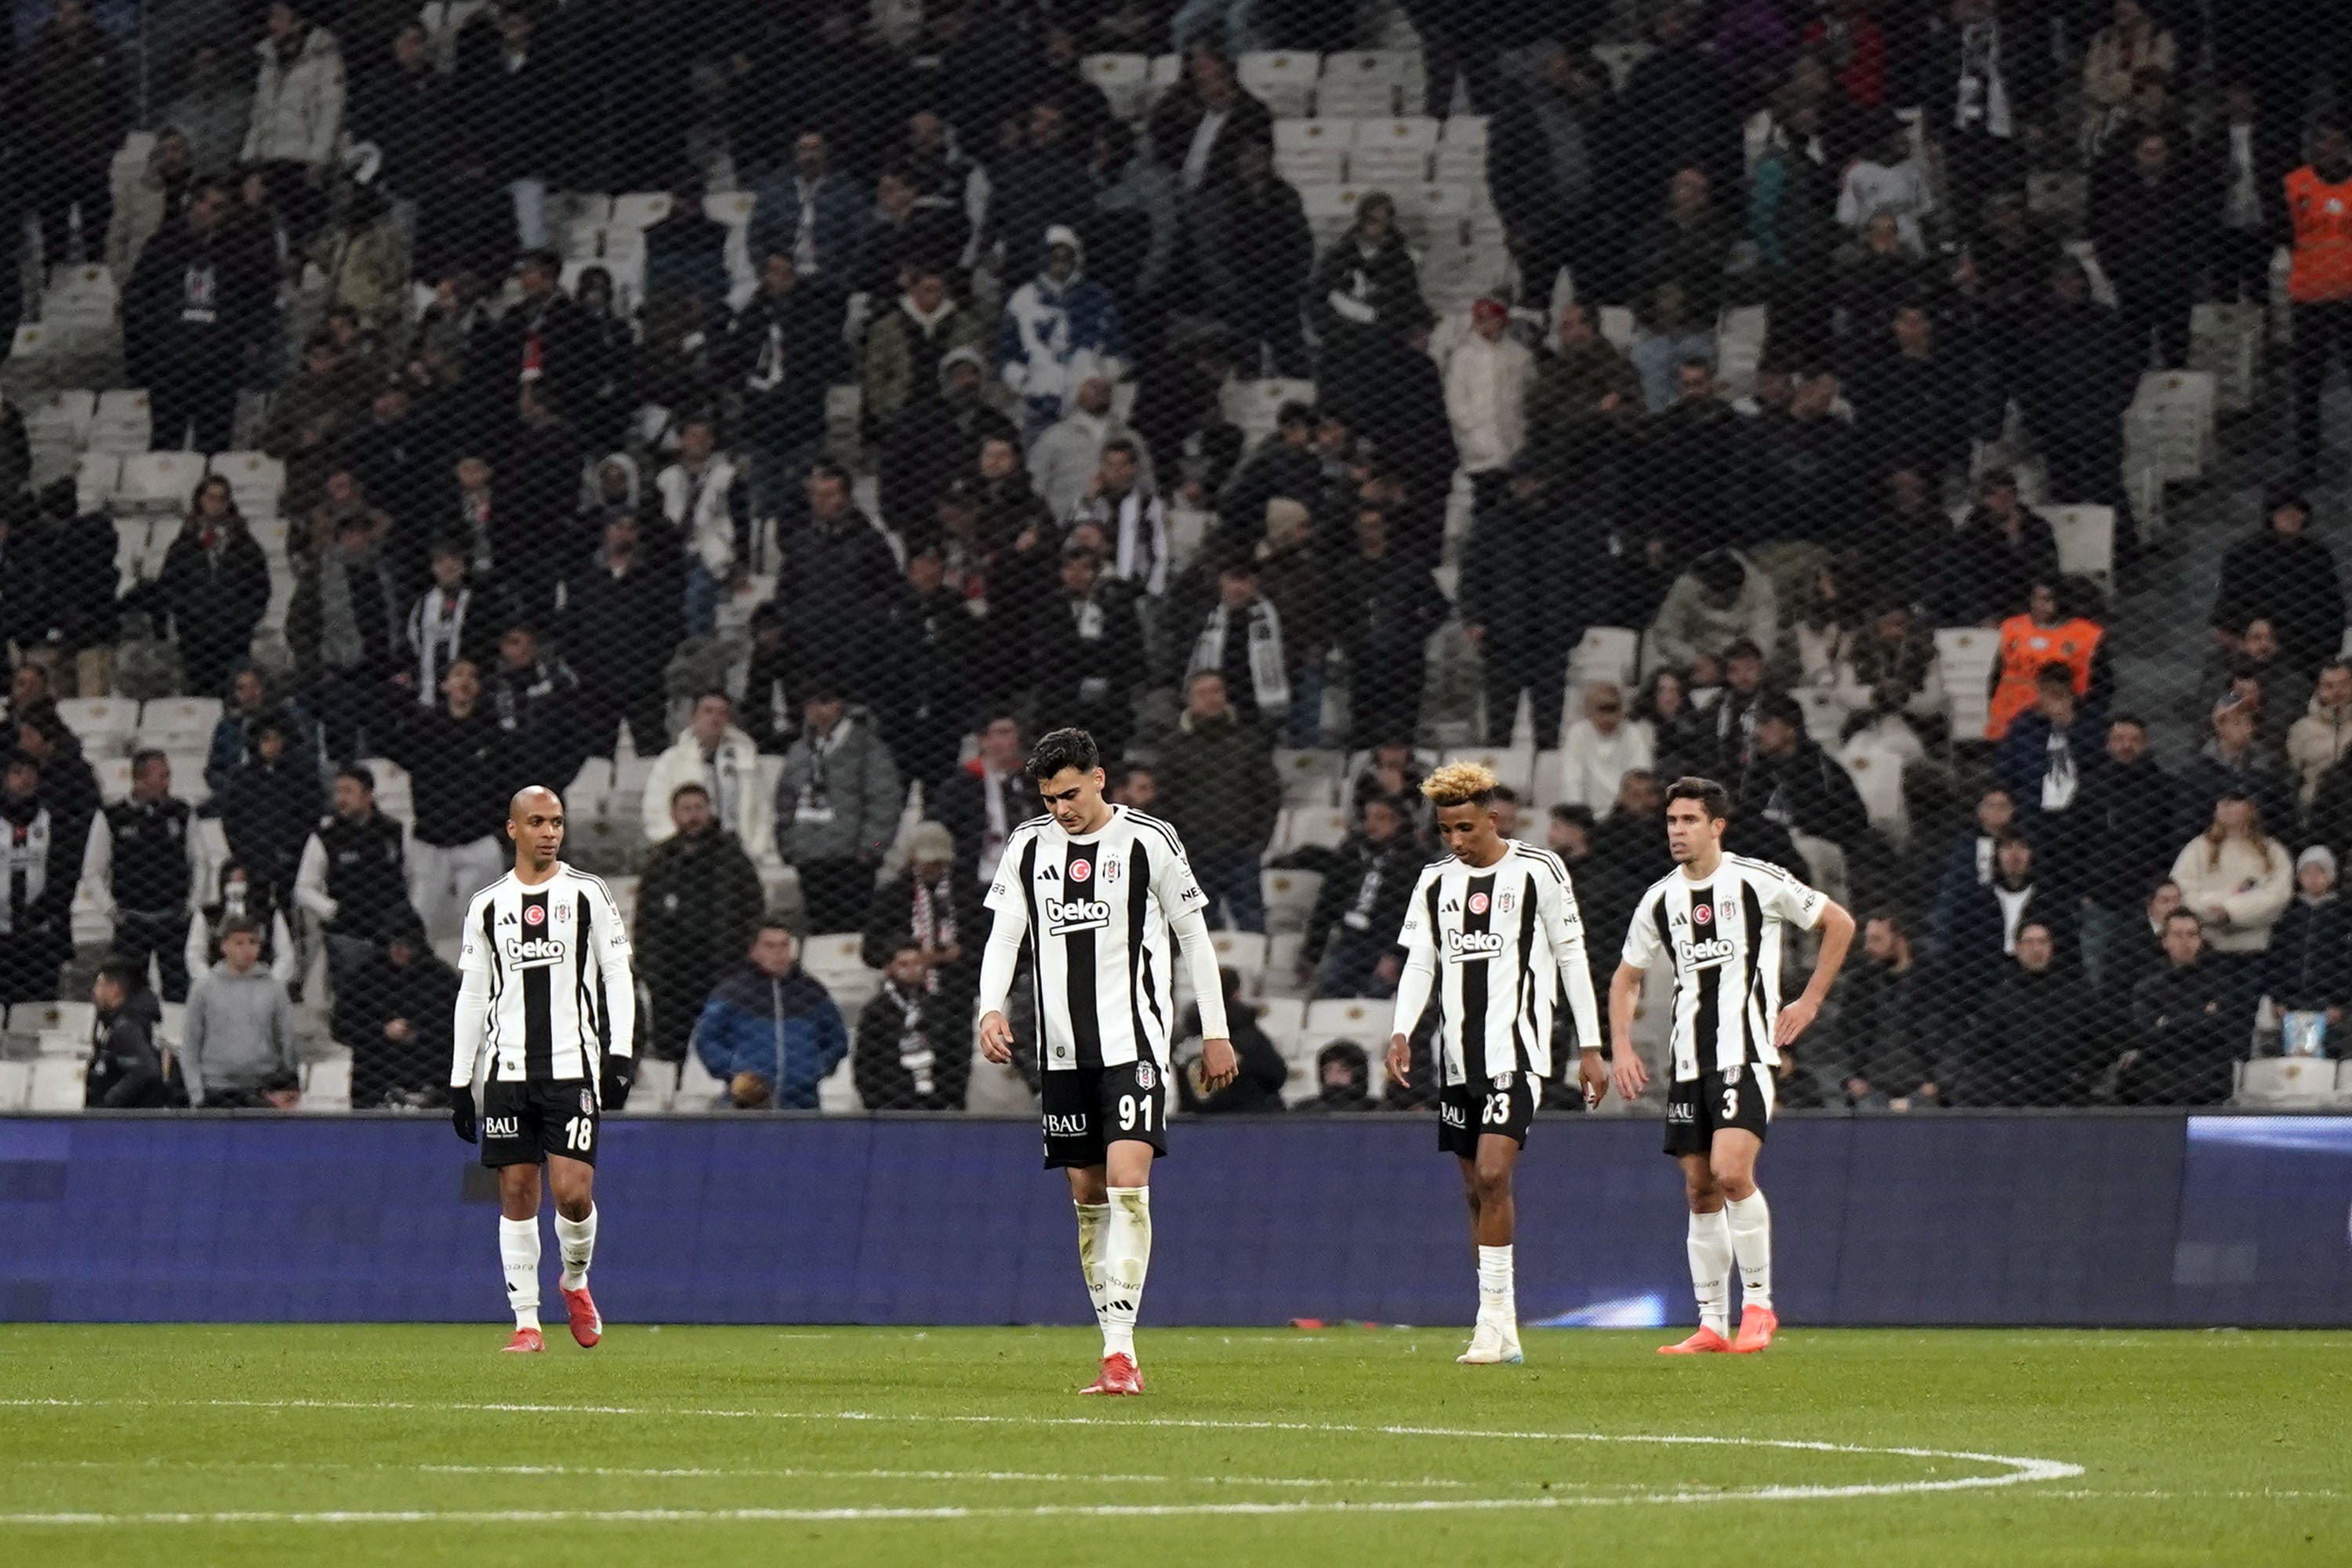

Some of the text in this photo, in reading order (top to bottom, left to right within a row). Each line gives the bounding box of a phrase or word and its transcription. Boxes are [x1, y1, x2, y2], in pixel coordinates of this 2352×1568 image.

[1046, 898, 1110, 922] beko
[506, 938, 565, 959] beko
[1448, 929, 1504, 952] beko
[1680, 938, 1734, 960] beko
[1118, 1094, 1152, 1132] 91
[1722, 1088, 1739, 1120] 3
[485, 1116, 518, 1134] BAU
[565, 1116, 593, 1152] 18
[1047, 1113, 1087, 1132] BAU
